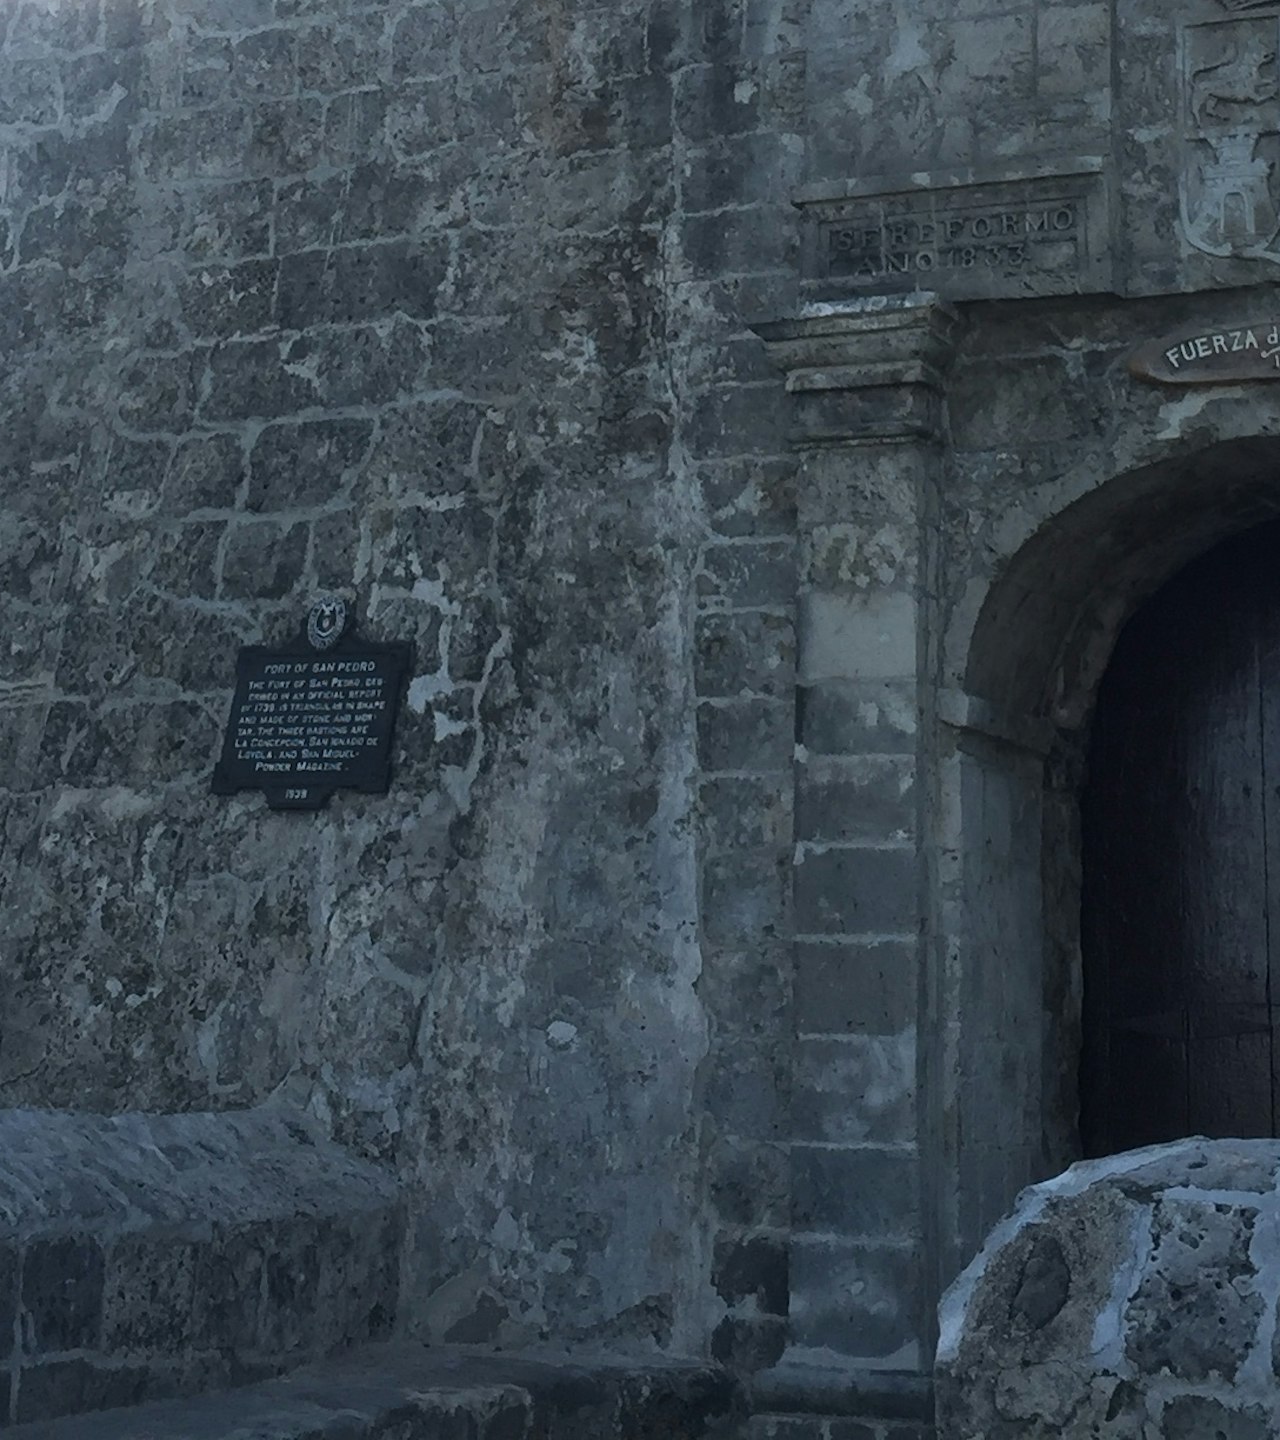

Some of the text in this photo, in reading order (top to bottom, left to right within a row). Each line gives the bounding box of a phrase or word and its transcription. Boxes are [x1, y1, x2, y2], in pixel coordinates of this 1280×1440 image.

[945, 243, 1026, 270] 1833
[1166, 329, 1259, 368] FUERZA
[264, 661, 376, 675] FORT OF SAN PEDRO
[248, 680, 266, 690] THE
[268, 680, 291, 690] FORT
[293, 679, 307, 689] OF
[280, 691, 290, 701] IN
[292, 691, 306, 701] AN
[307, 689, 345, 701] OFFICIAL
[348, 688, 383, 699] REPORT
[279, 702, 289, 712] IS
[290, 701, 343, 712] TRIANGULAR
[345, 701, 355, 711] IN
[356, 700, 386, 711] SHAPE
[238, 715, 257, 725] AND
[260, 714, 285, 725] MADE
[287, 714, 300, 724] OF
[302, 714, 332, 724] STONE
[333, 713, 352, 724] AND
[258, 726, 275, 736] THE
[278, 725, 306, 736] THREE
[306, 725, 348, 735] BASTIONS
[350, 724, 370, 735] ARE
[330, 736, 365, 747] IGNACIO
[366, 736, 380, 746] DE
[278, 749, 298, 760] AND
[255, 761, 292, 772] POWDER
